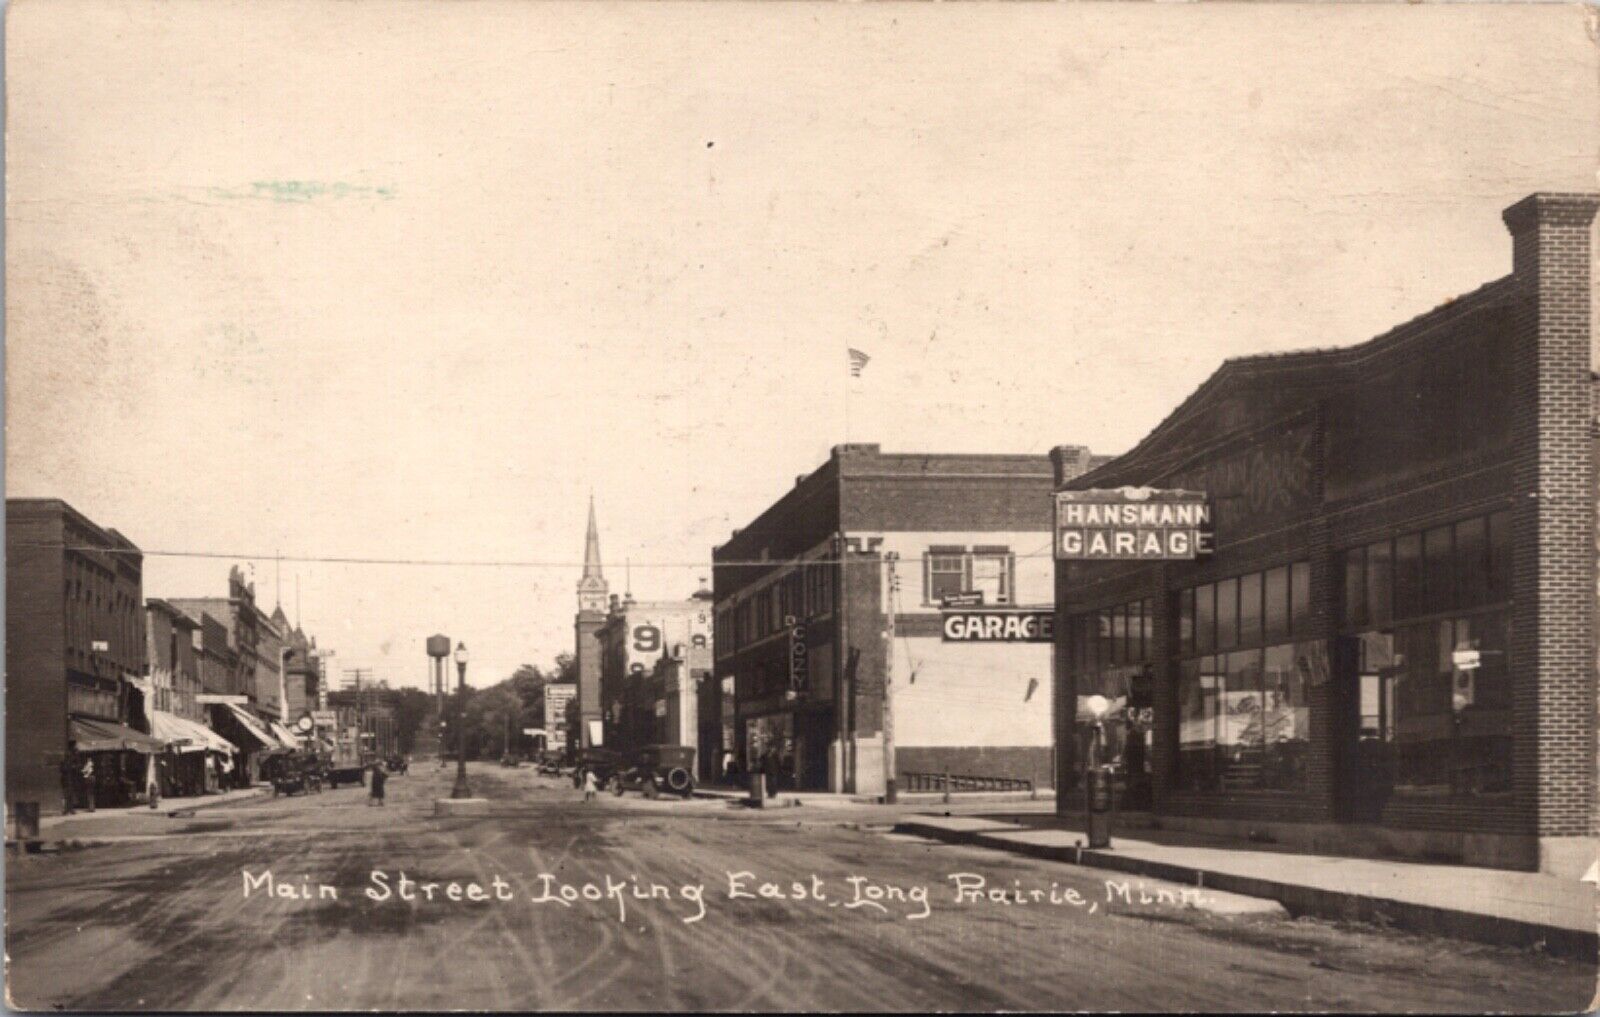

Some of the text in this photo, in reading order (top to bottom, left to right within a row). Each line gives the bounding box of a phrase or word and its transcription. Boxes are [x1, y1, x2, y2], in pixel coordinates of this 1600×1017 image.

[1067, 503, 1210, 525] HANSMANN
[1063, 531, 1214, 555] GARAGE
[632, 624, 661, 652] 9
[944, 615, 1054, 639] GARAGE
